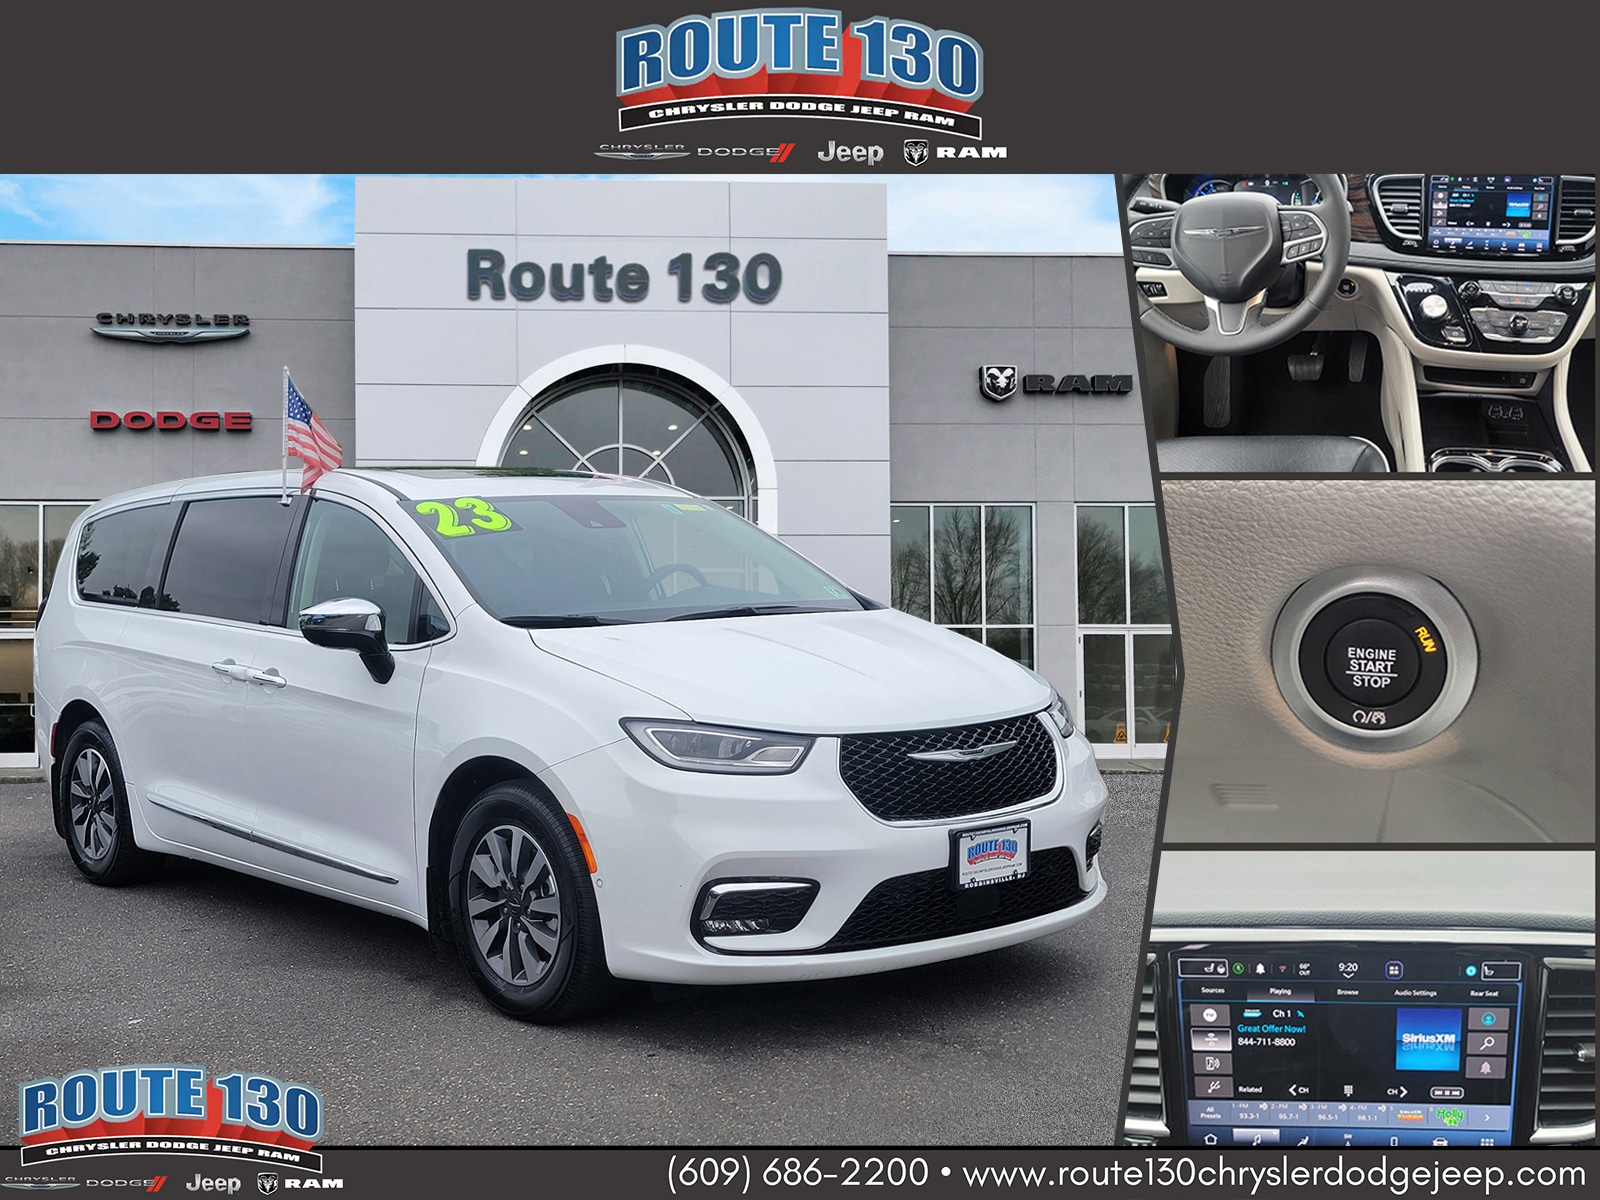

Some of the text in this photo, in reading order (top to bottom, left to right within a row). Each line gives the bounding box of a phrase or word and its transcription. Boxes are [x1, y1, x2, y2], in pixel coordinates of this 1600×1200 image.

[466, 248, 784, 304] Route 130
[96, 312, 250, 326] CHRYSLER
[1023, 374, 1133, 394] RAM
[89, 410, 252, 431] DODGE
[415, 496, 513, 537] 23
[1414, 625, 1437, 654] RUN
[1347, 647, 1397, 661] ENGINE
[1349, 659, 1395, 673] START
[1352, 675, 1391, 688] STOP
[967, 839, 1018, 859] ROUTE 130
[1337, 962, 1359, 972] 9:20
[1394, 989, 1412, 997] Audio
[1470, 989, 1486, 997] Rear
[1272, 1008, 1285, 1019] Ch
[1237, 1023, 1307, 1034] Great Offer Now!
[1237, 1037, 1297, 1047] 844-711-8800
[1402, 1033, 1456, 1044] SiriusXM
[1238, 1085, 1263, 1094] Related
[1436, 1107, 1465, 1122] Holly
